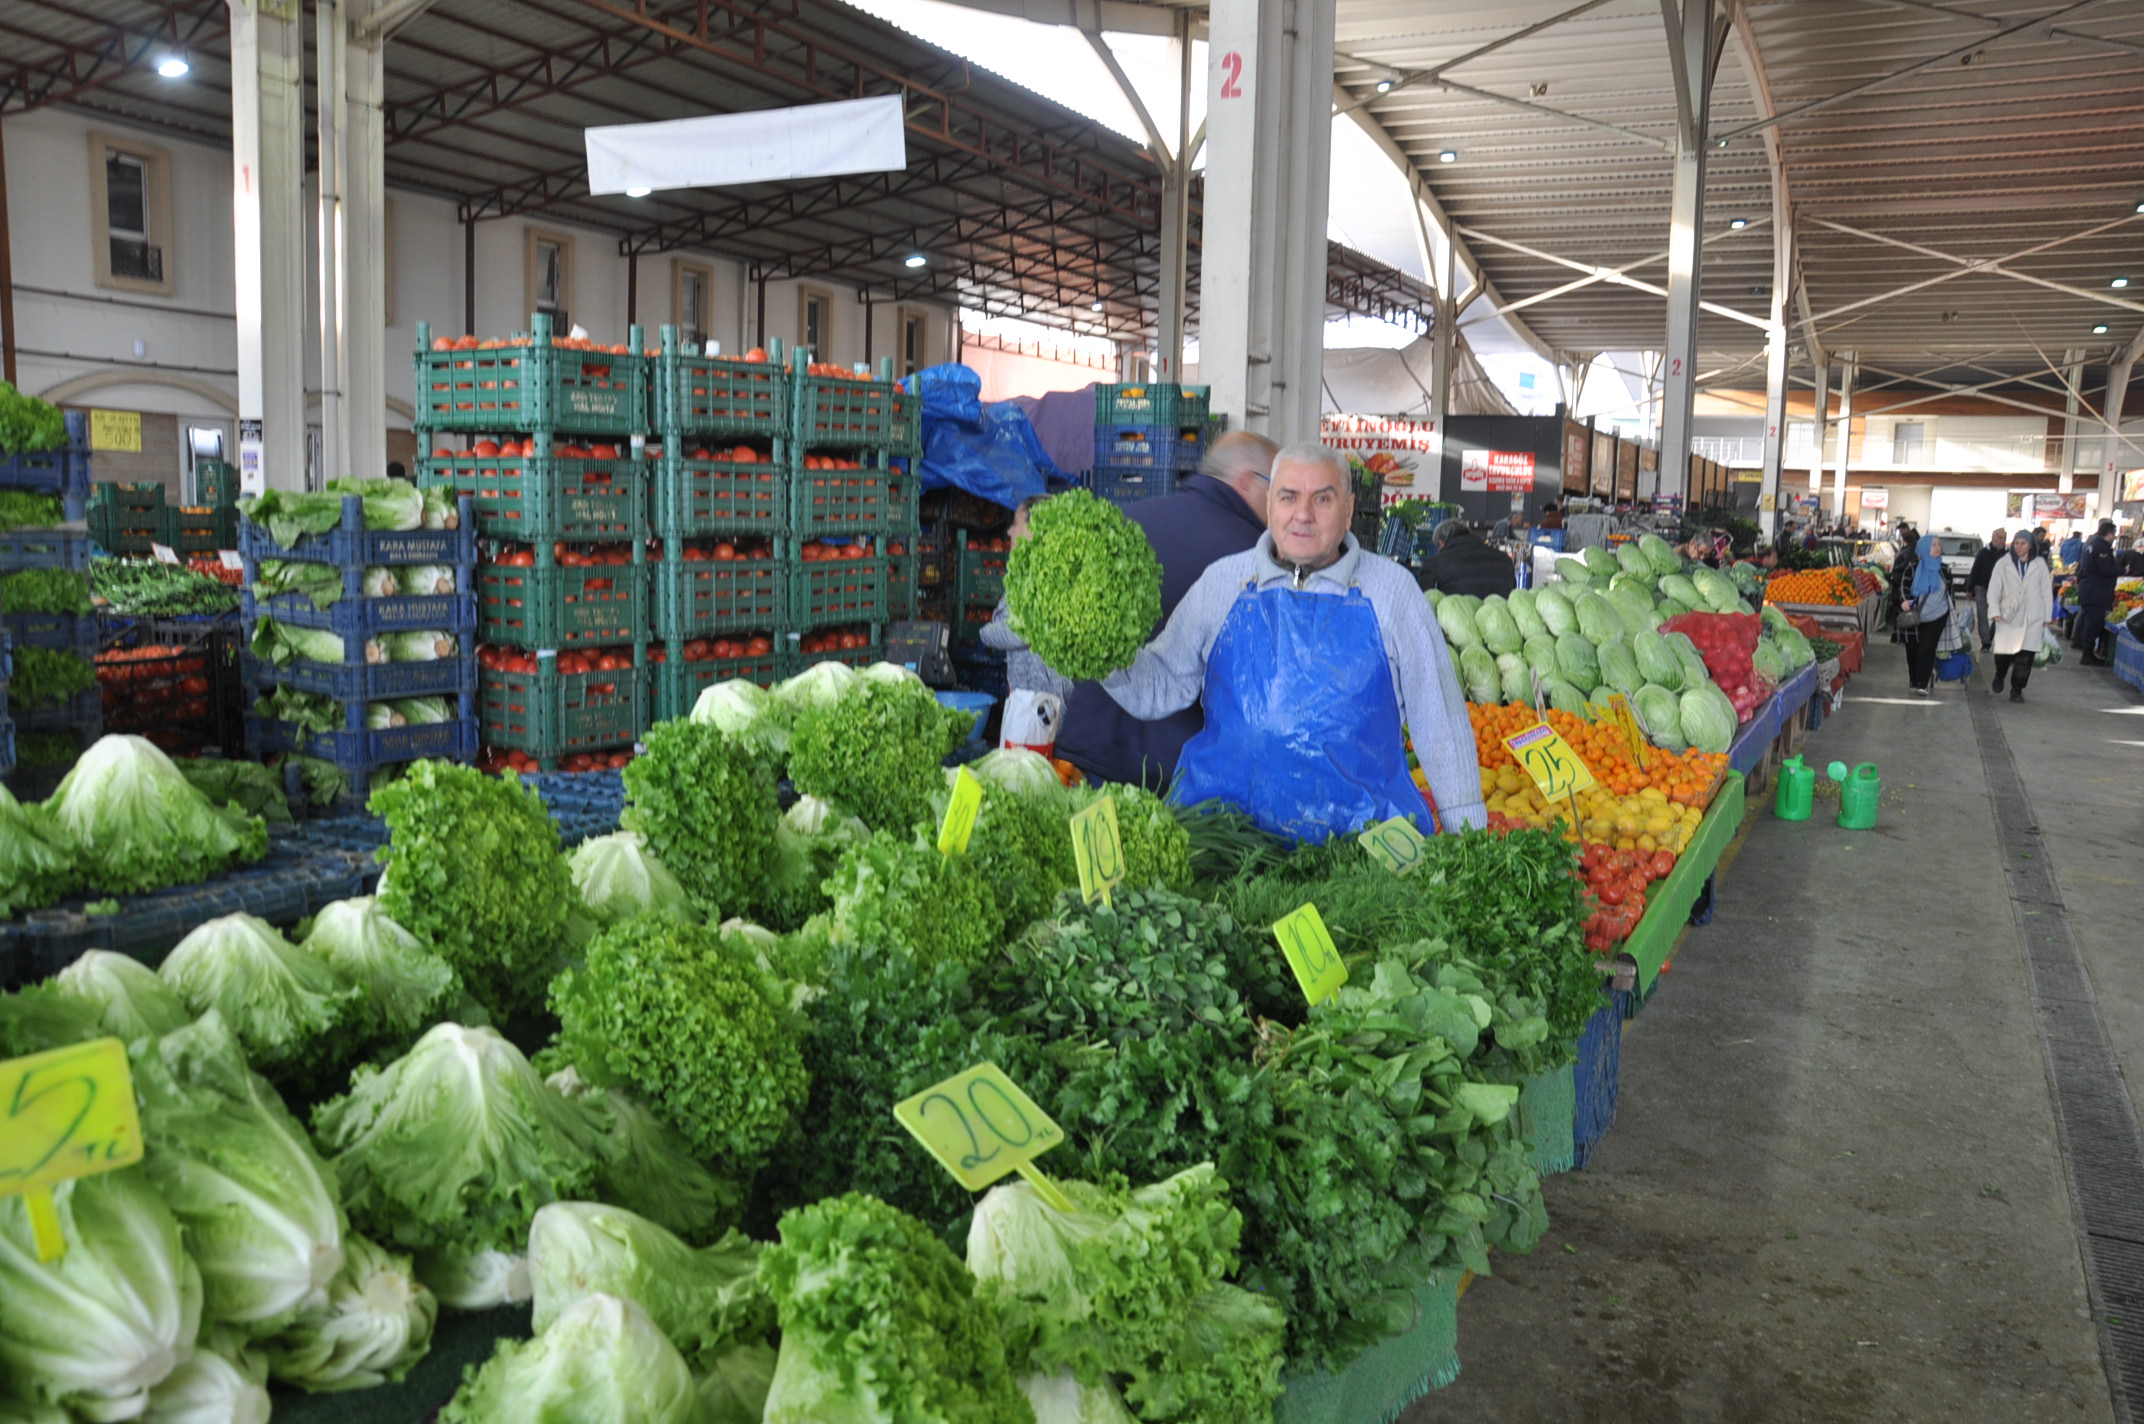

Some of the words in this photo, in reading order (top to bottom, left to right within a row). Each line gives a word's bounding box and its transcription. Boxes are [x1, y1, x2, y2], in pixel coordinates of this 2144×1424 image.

[1221, 51, 1243, 99] 2
[1672, 358, 1682, 376] 2
[1770, 426, 1777, 438] 2
[380, 540, 405, 552] KARA
[407, 540, 447, 551] MUSTAFA
[1525, 737, 1576, 796] 25
[1083, 808, 1117, 897] 10
[1372, 826, 1418, 870] 10
[1288, 912, 1326, 984] 10
[0, 1051, 99, 1179] 5
[920, 1077, 1032, 1169] 20
[1035, 1128, 1054, 1140] TL
